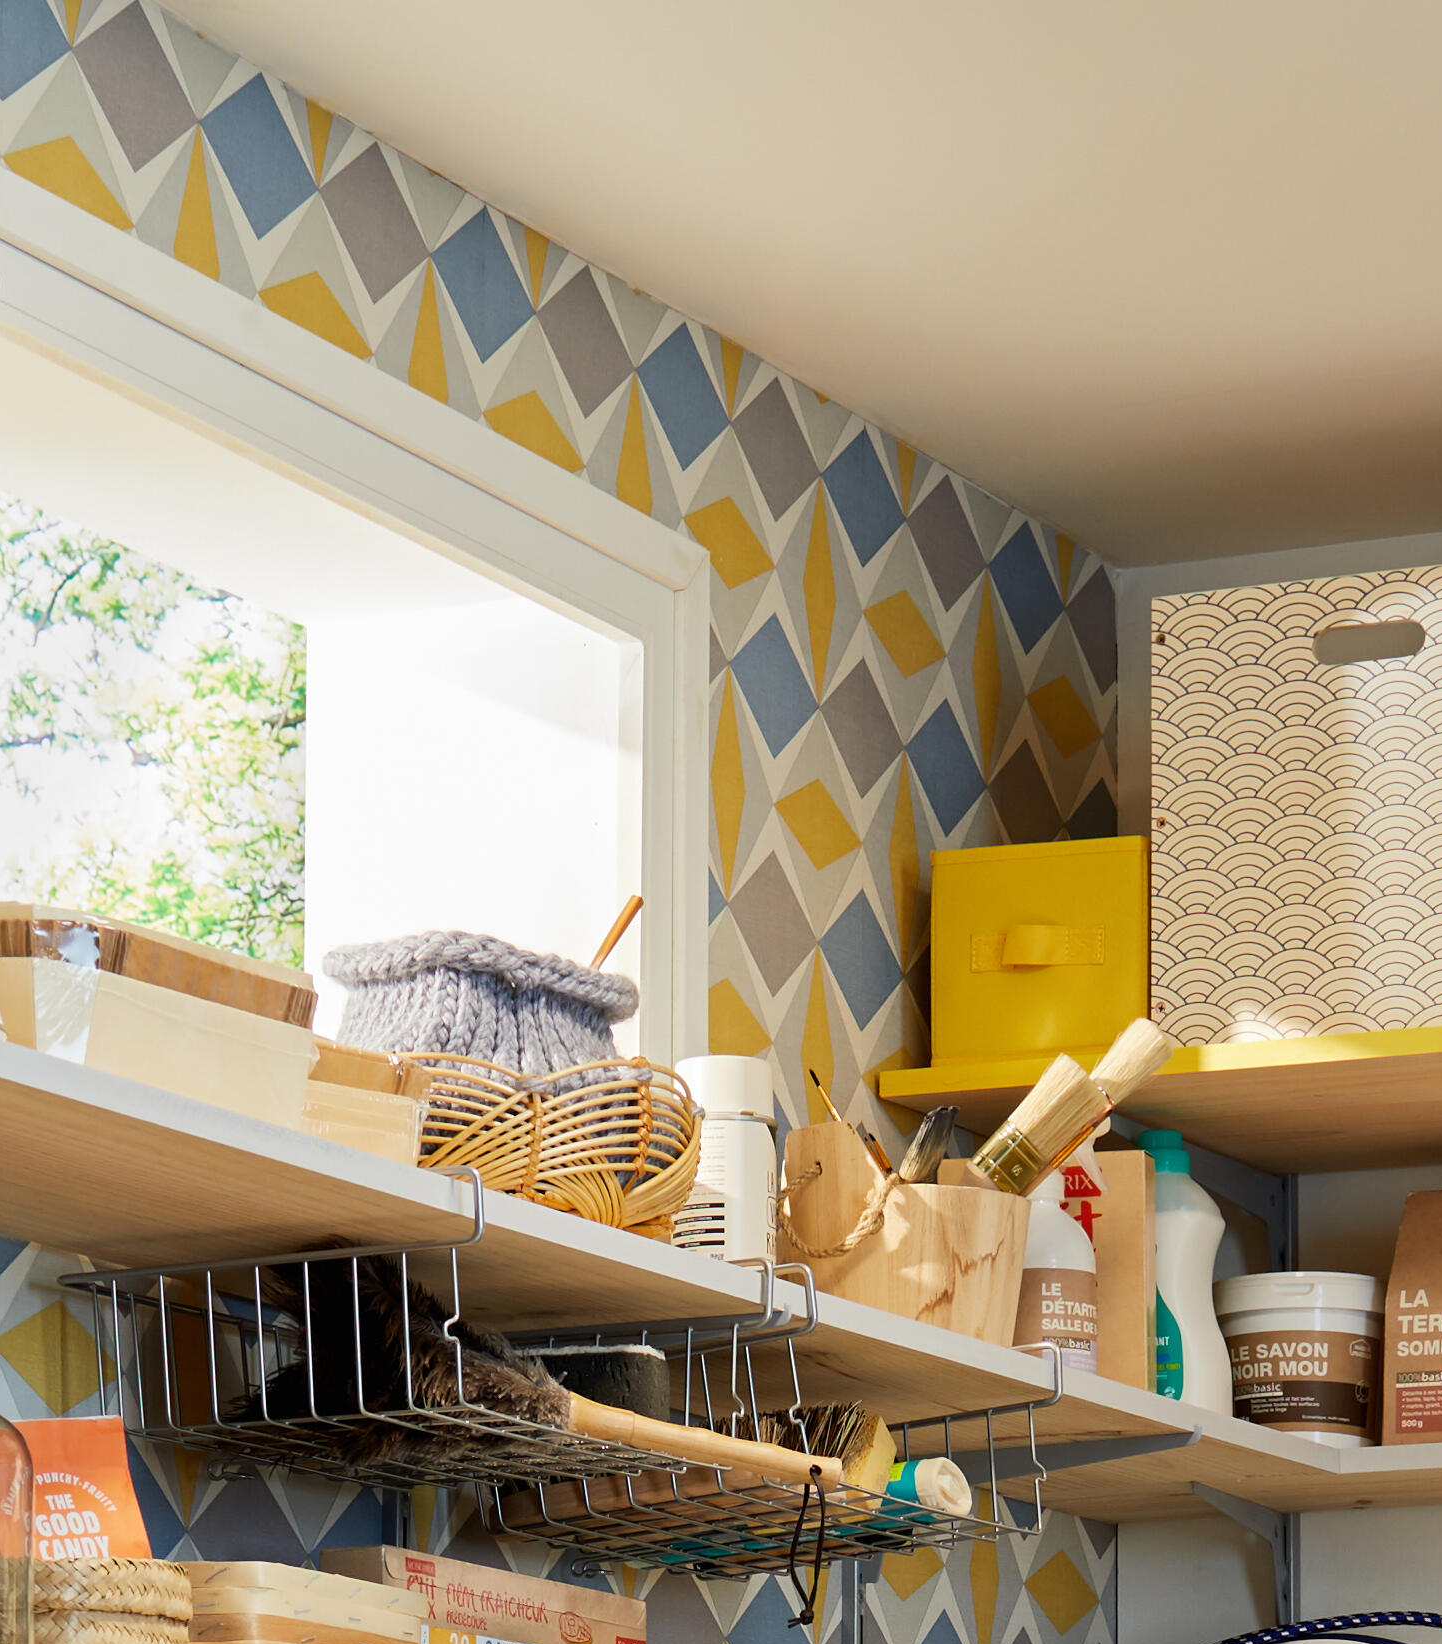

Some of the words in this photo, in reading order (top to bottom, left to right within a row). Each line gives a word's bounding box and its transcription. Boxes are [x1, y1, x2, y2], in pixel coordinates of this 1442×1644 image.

[1041, 1282, 1062, 1297] LE
[1399, 1289, 1429, 1308] LA
[1041, 1318, 1080, 1332] SALLE
[1232, 1345, 1250, 1361] LE
[1256, 1342, 1329, 1358] SAVON
[1233, 1361, 1273, 1380] NOIR
[1279, 1360, 1328, 1376] MOU
[44, 1493, 76, 1512] THE
[34, 1509, 102, 1538] GOOD
[38, 1535, 111, 1562] CANDY
